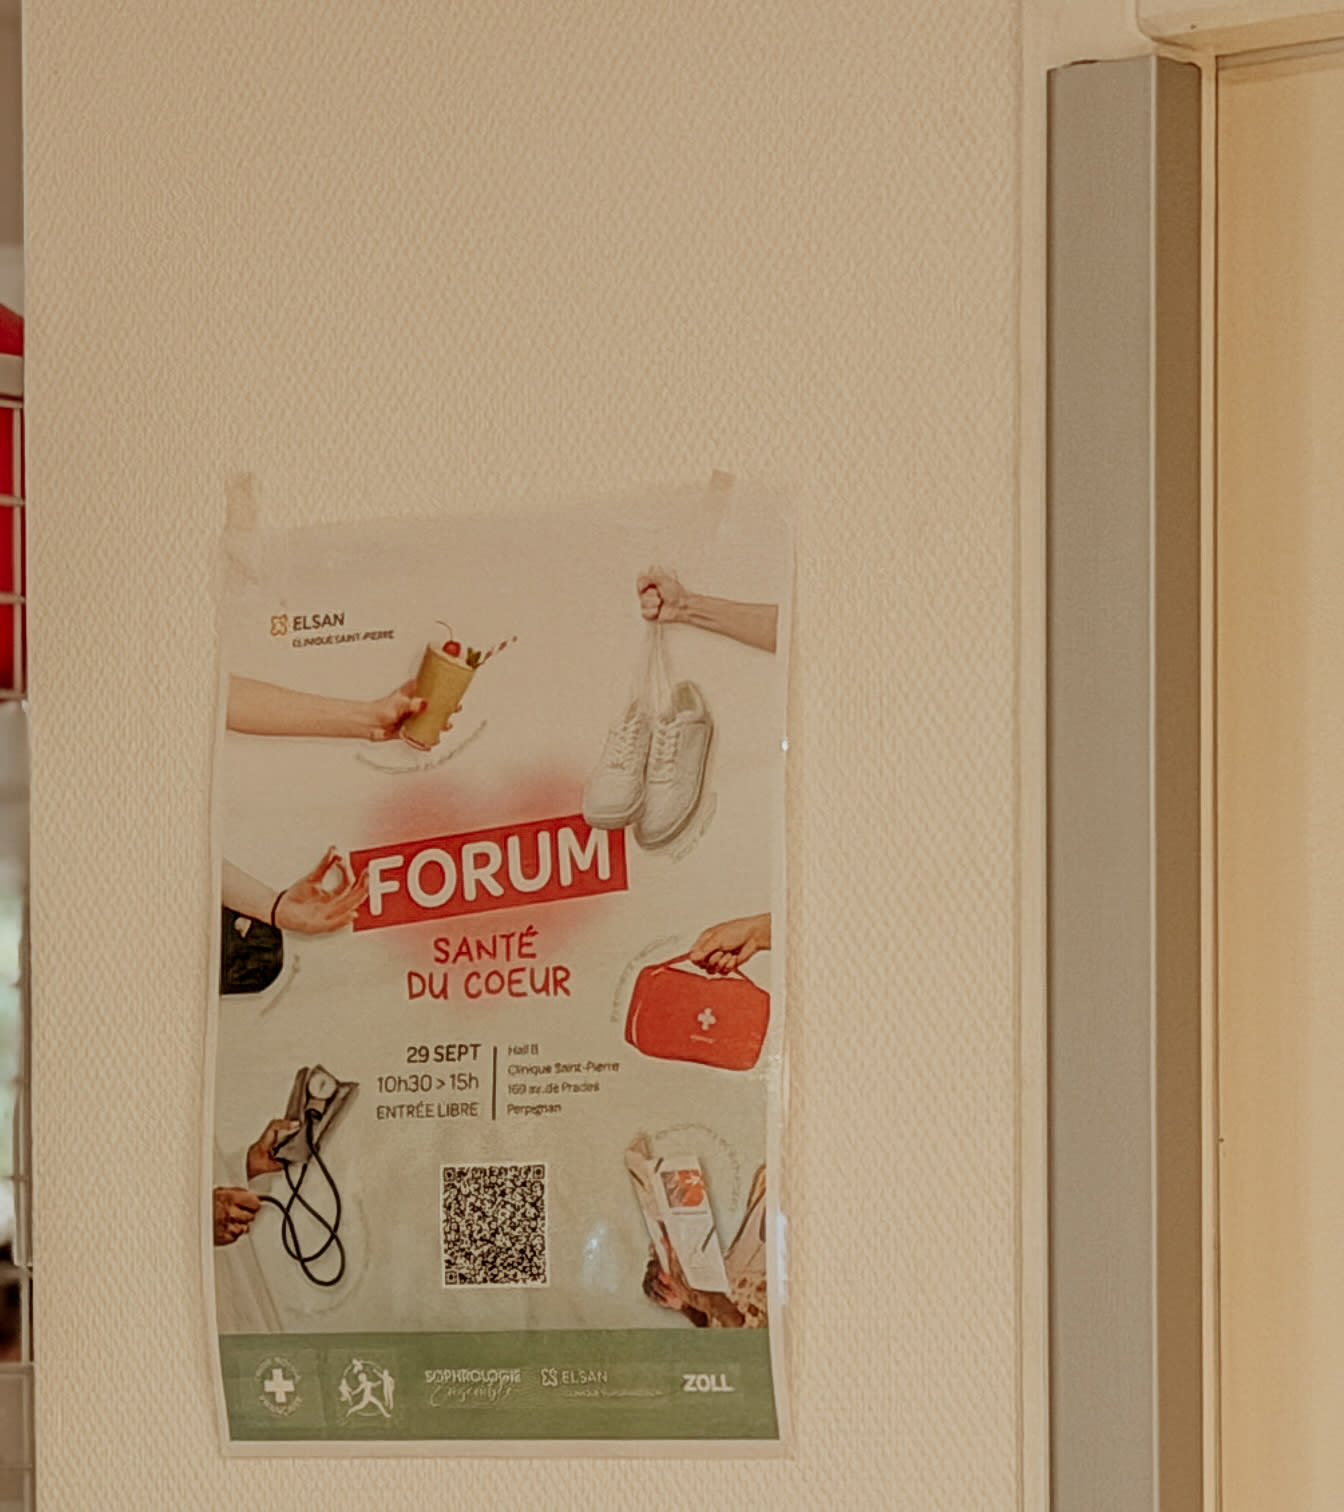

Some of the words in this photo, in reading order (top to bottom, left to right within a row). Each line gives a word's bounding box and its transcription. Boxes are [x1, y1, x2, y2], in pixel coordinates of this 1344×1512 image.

[293, 612, 345, 632] ELSAN
[368, 826, 611, 917] FORUM
[433, 924, 539, 964] SANTÉ
[407, 971, 448, 1001] DU
[464, 965, 571, 999] COEUR
[406, 1046, 429, 1064] 29
[433, 1044, 482, 1063] SEPT
[377, 1074, 432, 1093] 10h30
[450, 1072, 480, 1091] 15h
[376, 1100, 435, 1120] ENTRÉE
[437, 1101, 479, 1118] LIBRE
[561, 1369, 608, 1385] ELSAN
[681, 1373, 735, 1393] ZOLL
